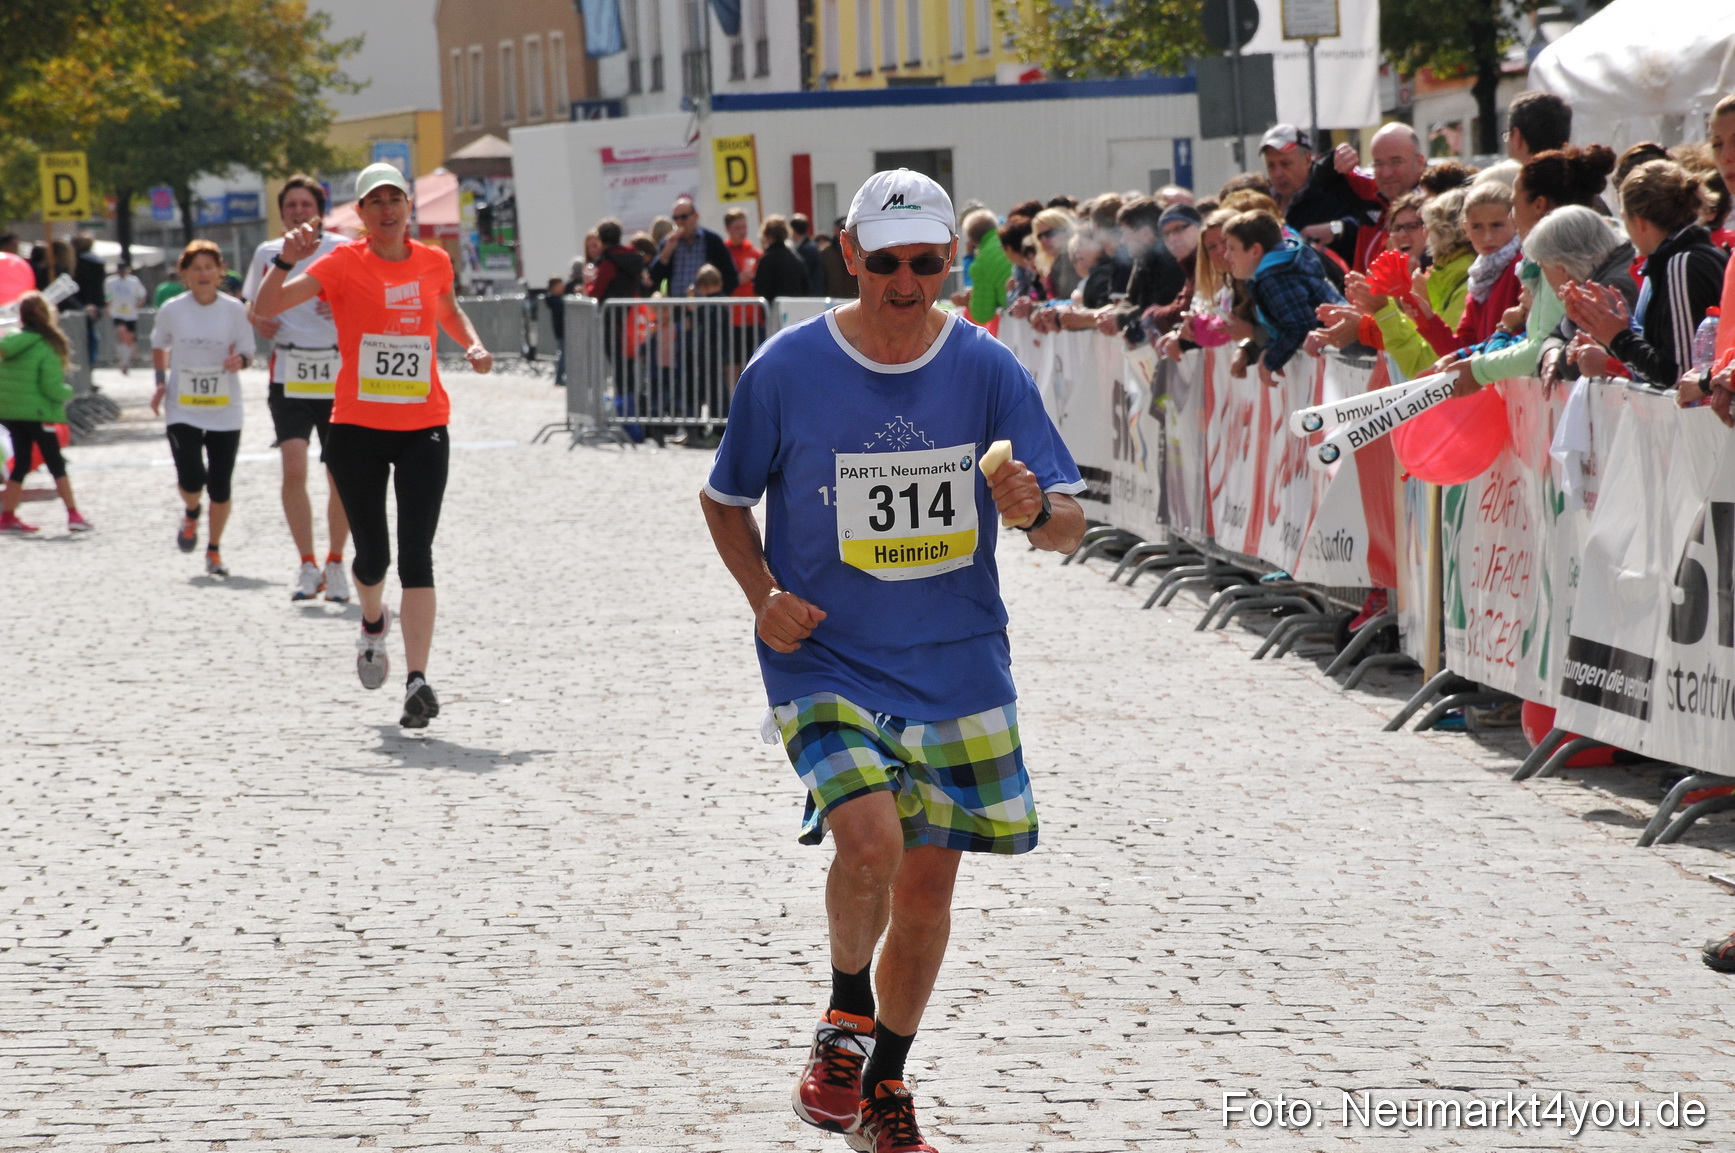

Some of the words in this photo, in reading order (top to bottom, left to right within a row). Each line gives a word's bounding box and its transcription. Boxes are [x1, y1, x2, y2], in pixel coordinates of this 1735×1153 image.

[725, 155, 748, 187] D
[54, 173, 77, 205] D
[297, 363, 330, 380] 514
[375, 351, 420, 378] 523
[190, 377, 219, 394] 197
[1347, 411, 1394, 448] BMW
[840, 467, 887, 479] PARTL
[891, 462, 956, 477] Neumarkt
[868, 481, 956, 532] 314
[844, 530, 851, 539] C
[875, 541, 949, 564] Heinrich
